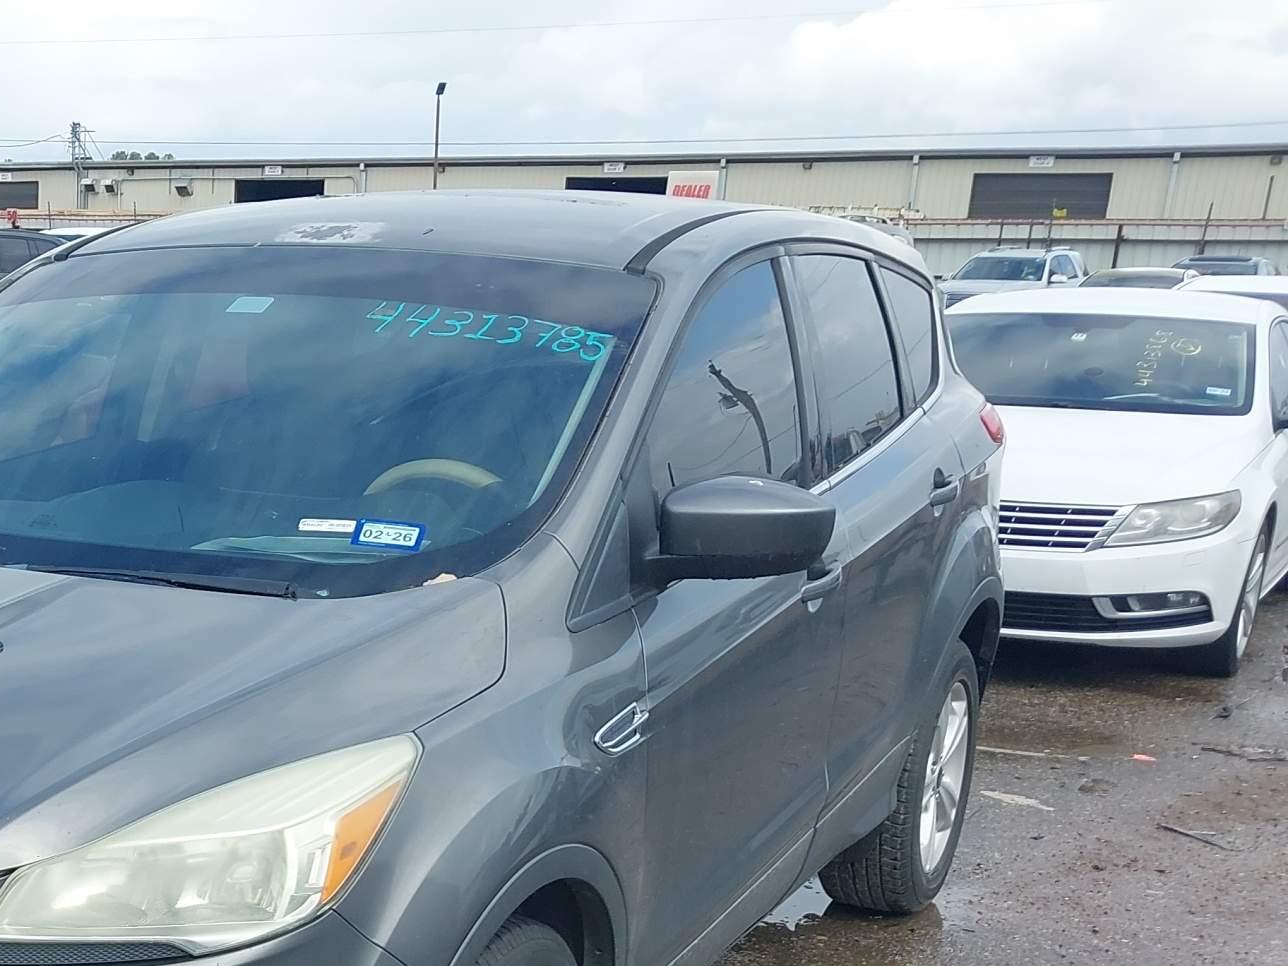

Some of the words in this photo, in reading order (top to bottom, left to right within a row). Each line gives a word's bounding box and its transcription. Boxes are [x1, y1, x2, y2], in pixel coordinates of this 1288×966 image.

[672, 184, 711, 199] DEALER
[366, 301, 614, 361] 44313785
[363, 529, 384, 540] 02
[393, 532, 414, 543] 26
